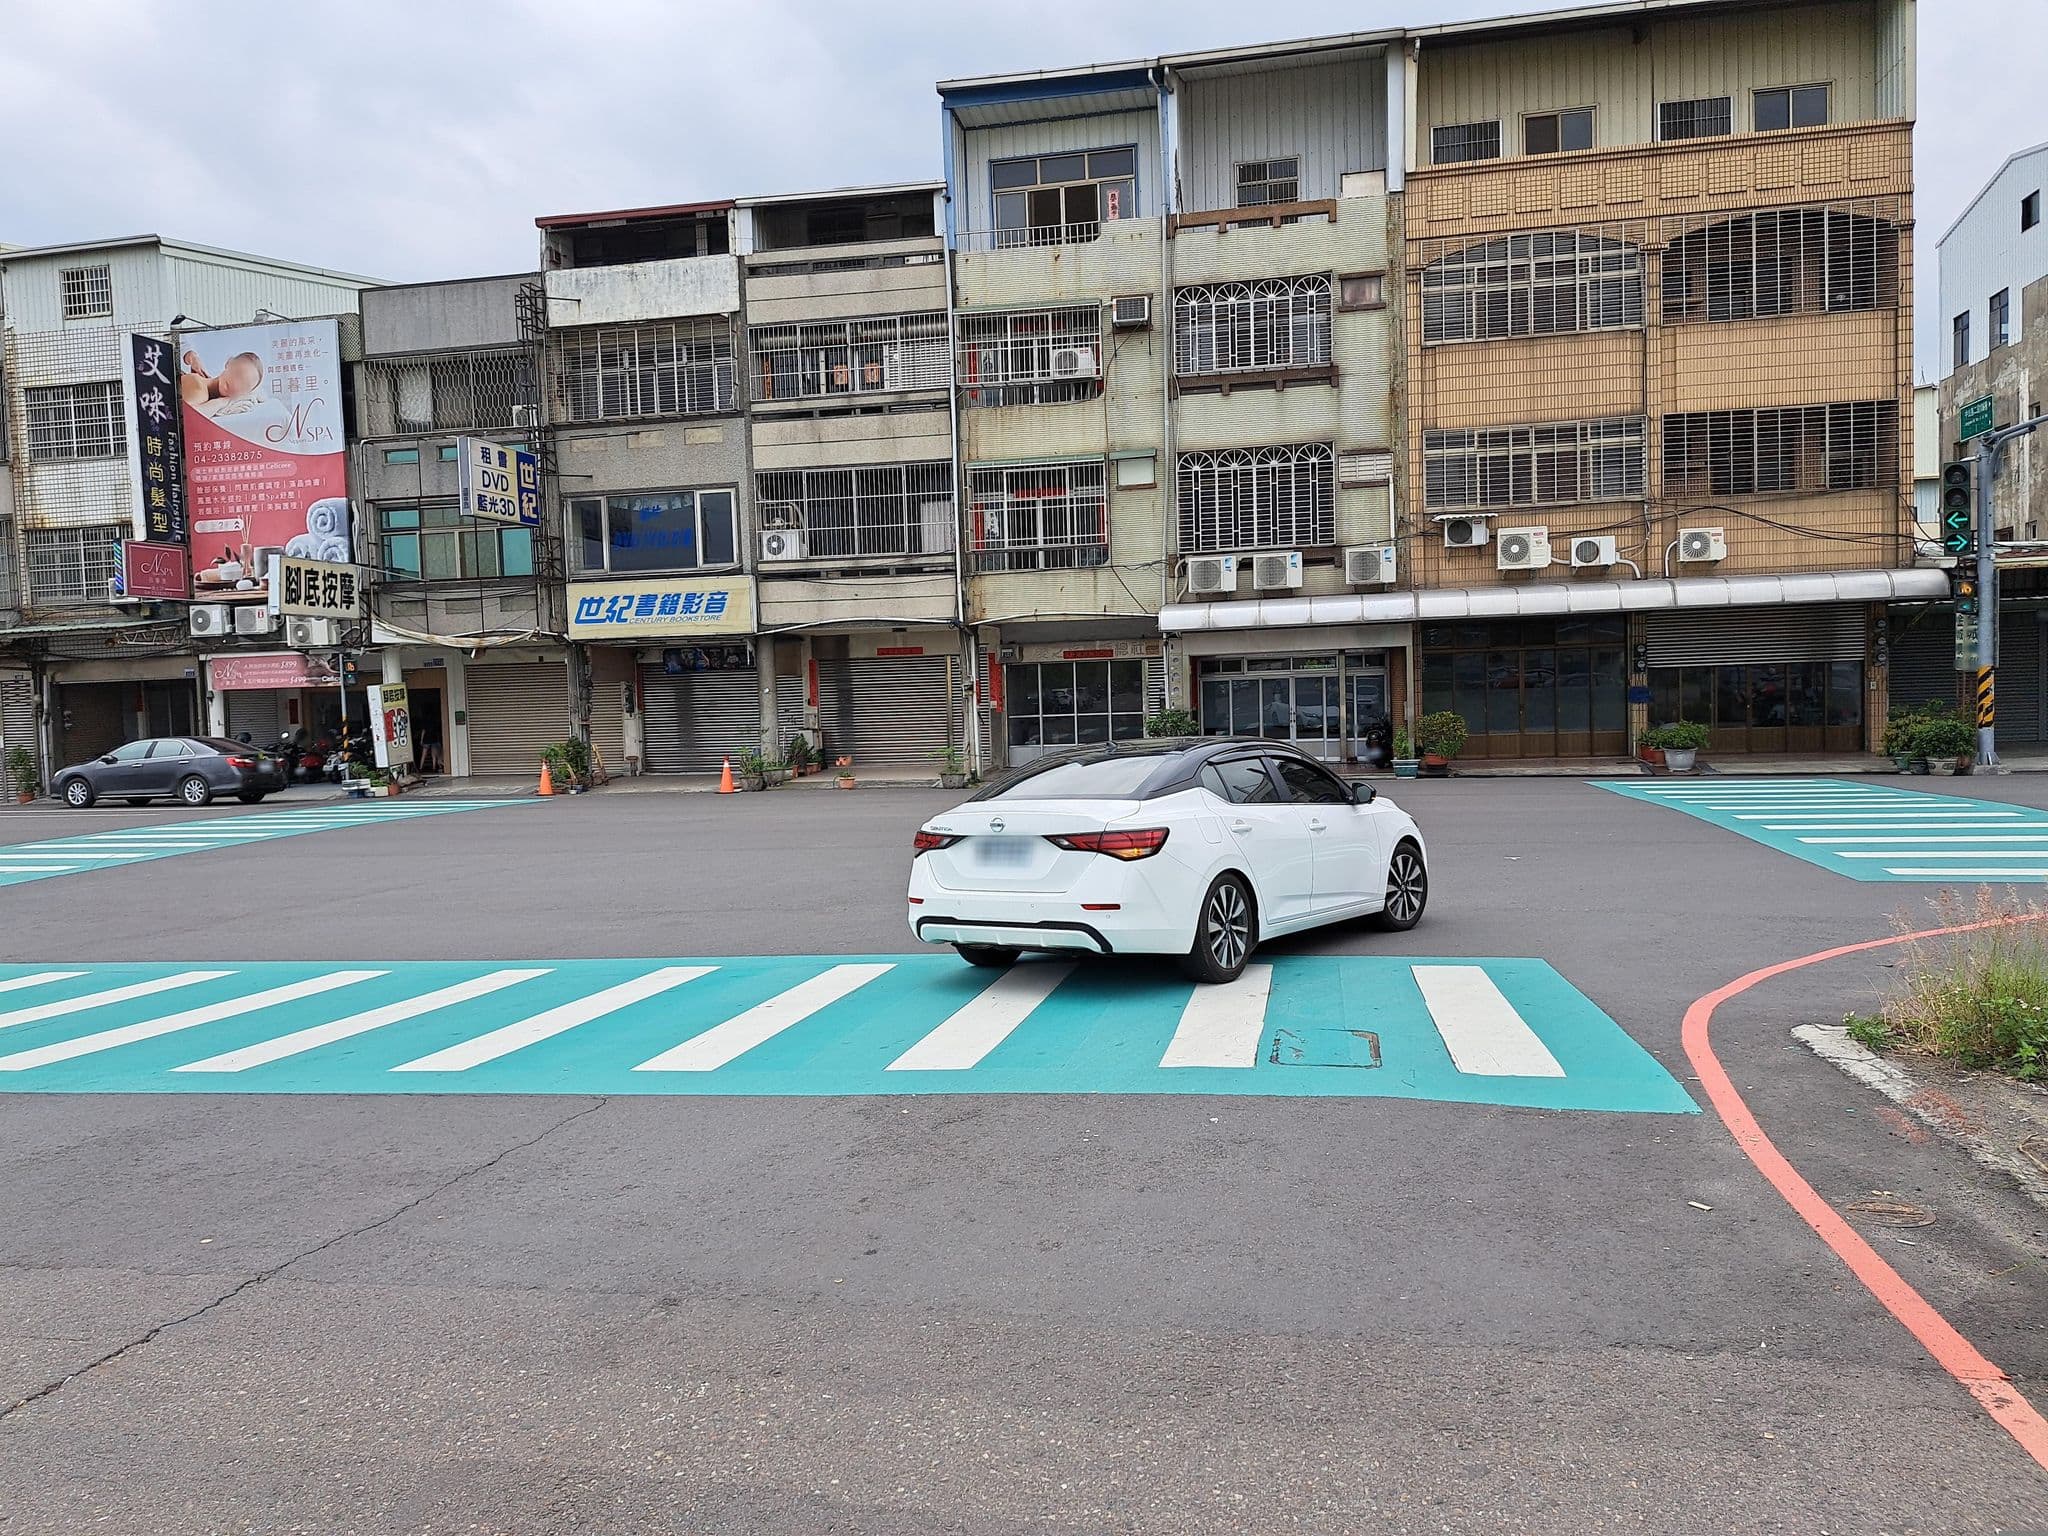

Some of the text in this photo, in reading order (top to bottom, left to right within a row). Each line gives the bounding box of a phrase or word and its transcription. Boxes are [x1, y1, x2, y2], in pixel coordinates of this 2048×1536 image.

[141, 344, 171, 424] 艾咪
[168, 431, 178, 482] Fashion
[194, 450, 263, 465] 04-23382875
[147, 435, 169, 533] 時尚髮型
[482, 470, 509, 492] DVD
[519, 461, 538, 519] 世紀
[477, 493, 516, 517] 藍光3D
[284, 565, 355, 611] 腳底按摩
[574, 590, 729, 625] 世紀書籍影音
[629, 613, 722, 625] CENTURY BOOKSTORE
